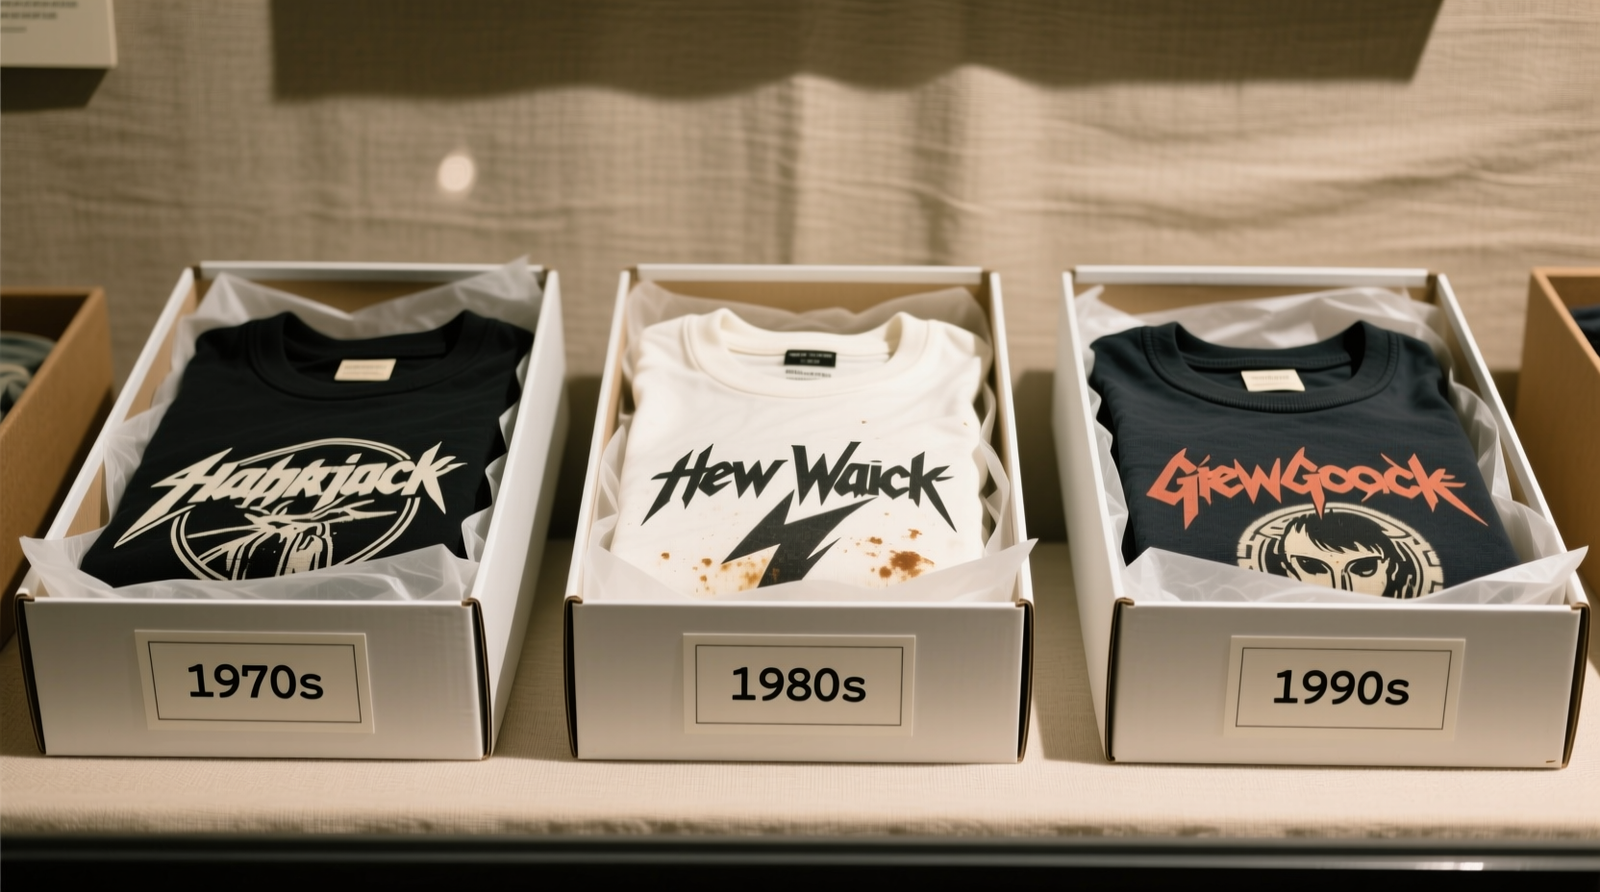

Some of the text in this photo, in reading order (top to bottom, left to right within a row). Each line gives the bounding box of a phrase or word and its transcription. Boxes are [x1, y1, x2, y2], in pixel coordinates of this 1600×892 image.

[640, 444, 788, 526] Hew
[187, 662, 324, 701] 1970s
[731, 666, 867, 703] 1980s
[1273, 669, 1410, 706] 1990s
